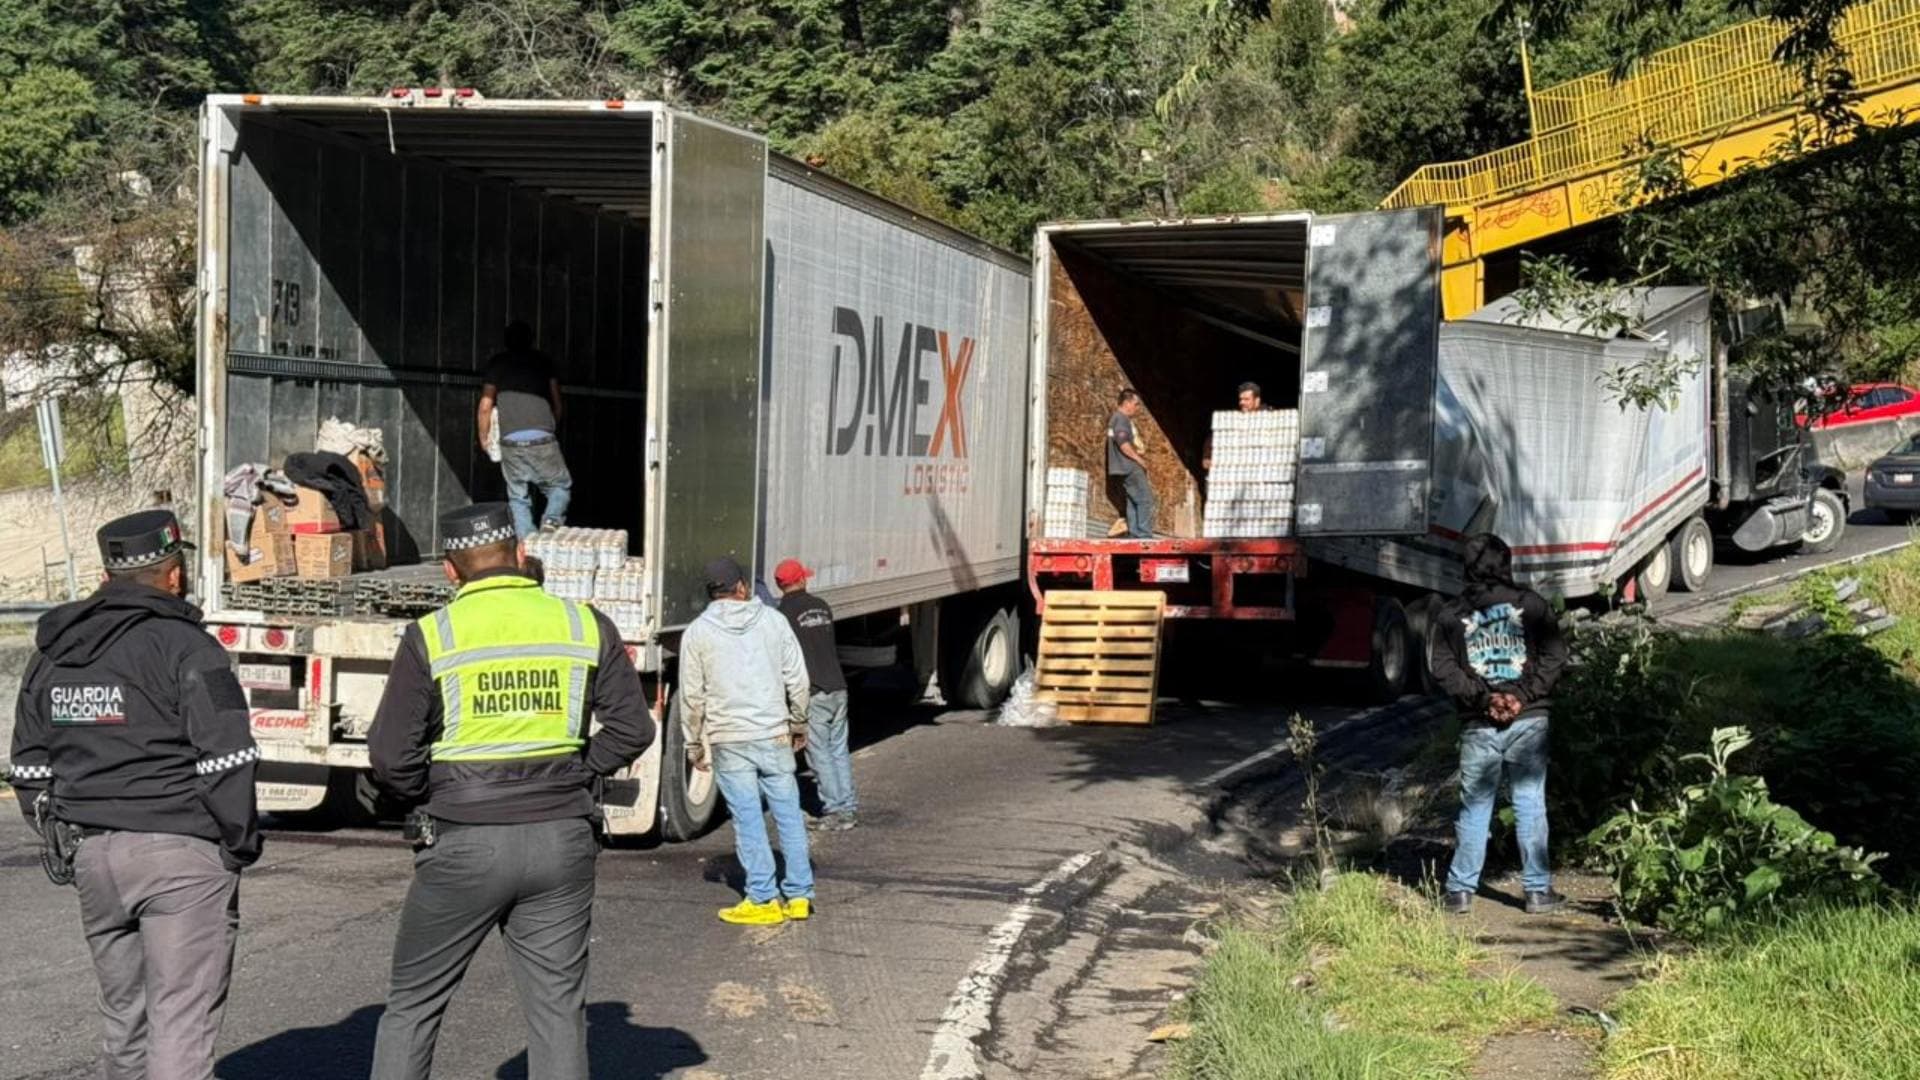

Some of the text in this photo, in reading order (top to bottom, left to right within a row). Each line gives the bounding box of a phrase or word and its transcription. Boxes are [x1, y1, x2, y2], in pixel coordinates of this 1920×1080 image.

[826, 306, 976, 458] DMEX
[477, 669, 560, 692] GUARDIA
[51, 686, 123, 704] GUARDIA
[472, 691, 563, 714] NACIONAL
[51, 703, 124, 717] NACIONAL
